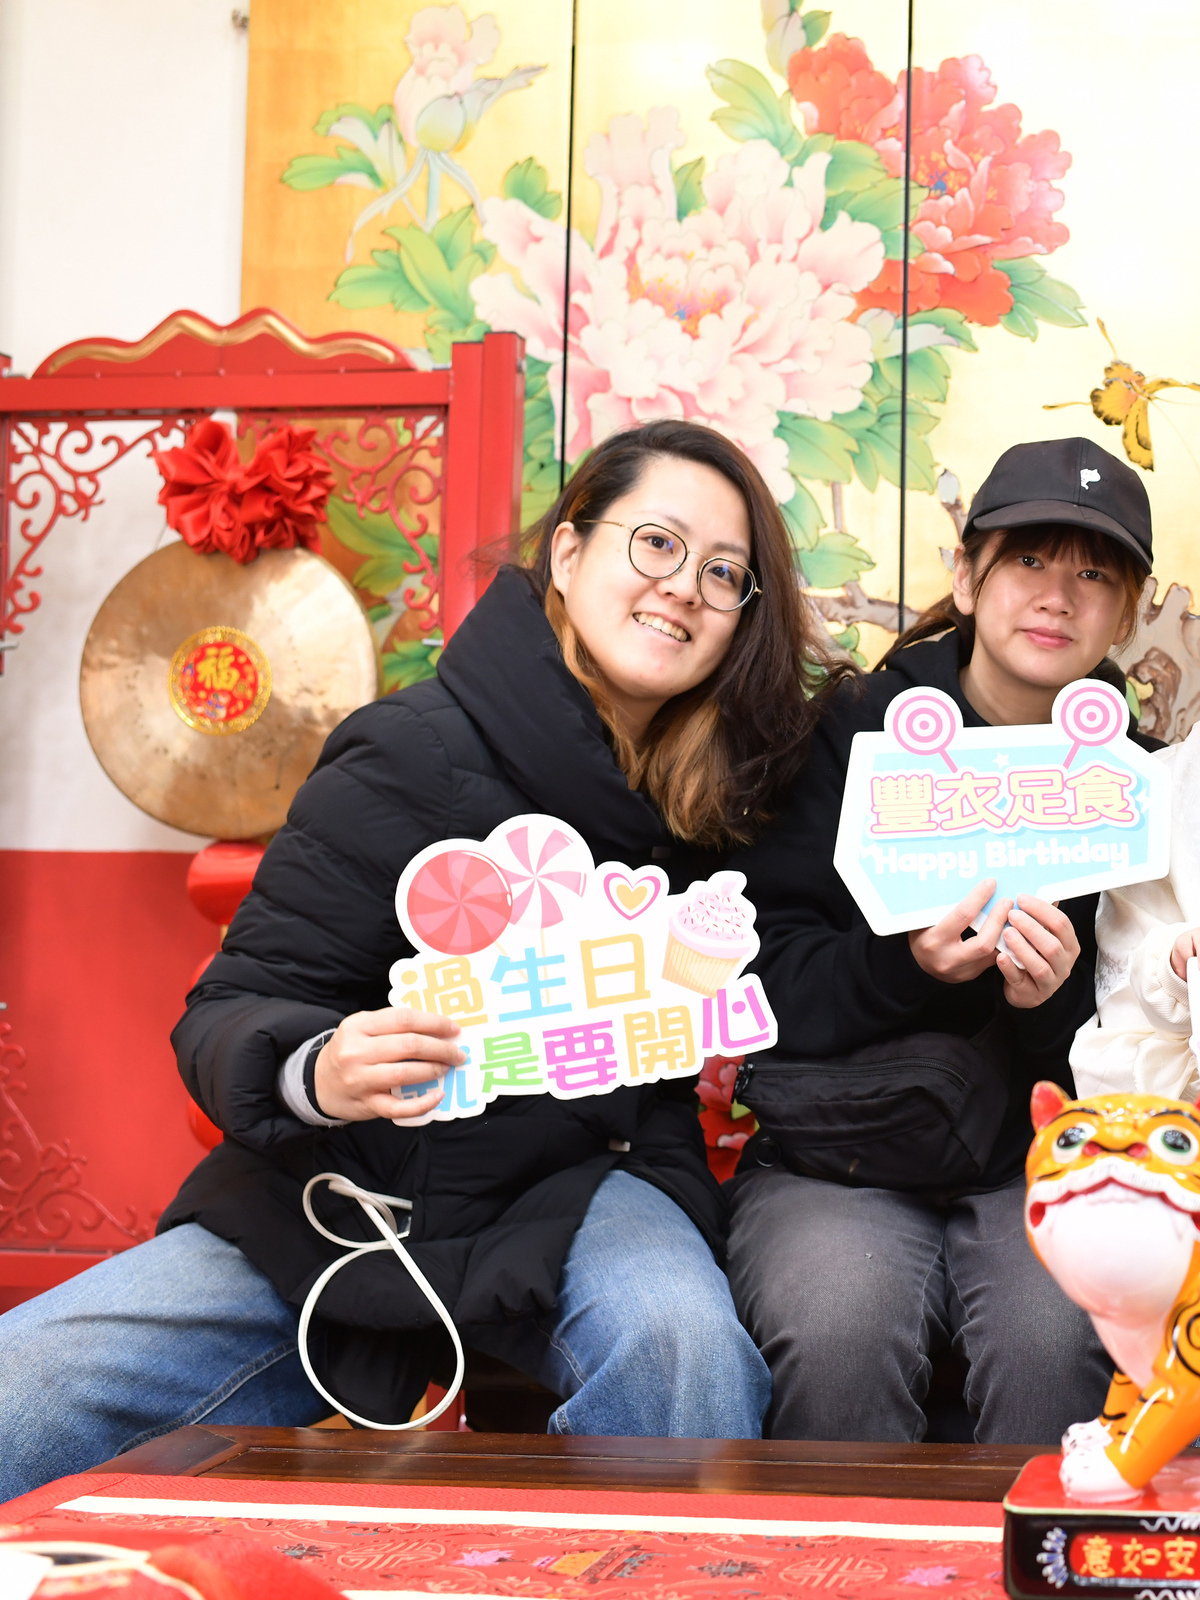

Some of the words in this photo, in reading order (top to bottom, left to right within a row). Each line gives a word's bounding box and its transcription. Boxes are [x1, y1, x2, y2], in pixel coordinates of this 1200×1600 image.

[197, 646, 240, 691] 福
[870, 765, 1135, 833] 豐衣足食
[862, 842, 978, 880] Happy
[985, 836, 1130, 871] Birthday
[401, 933, 652, 1029] 過生日
